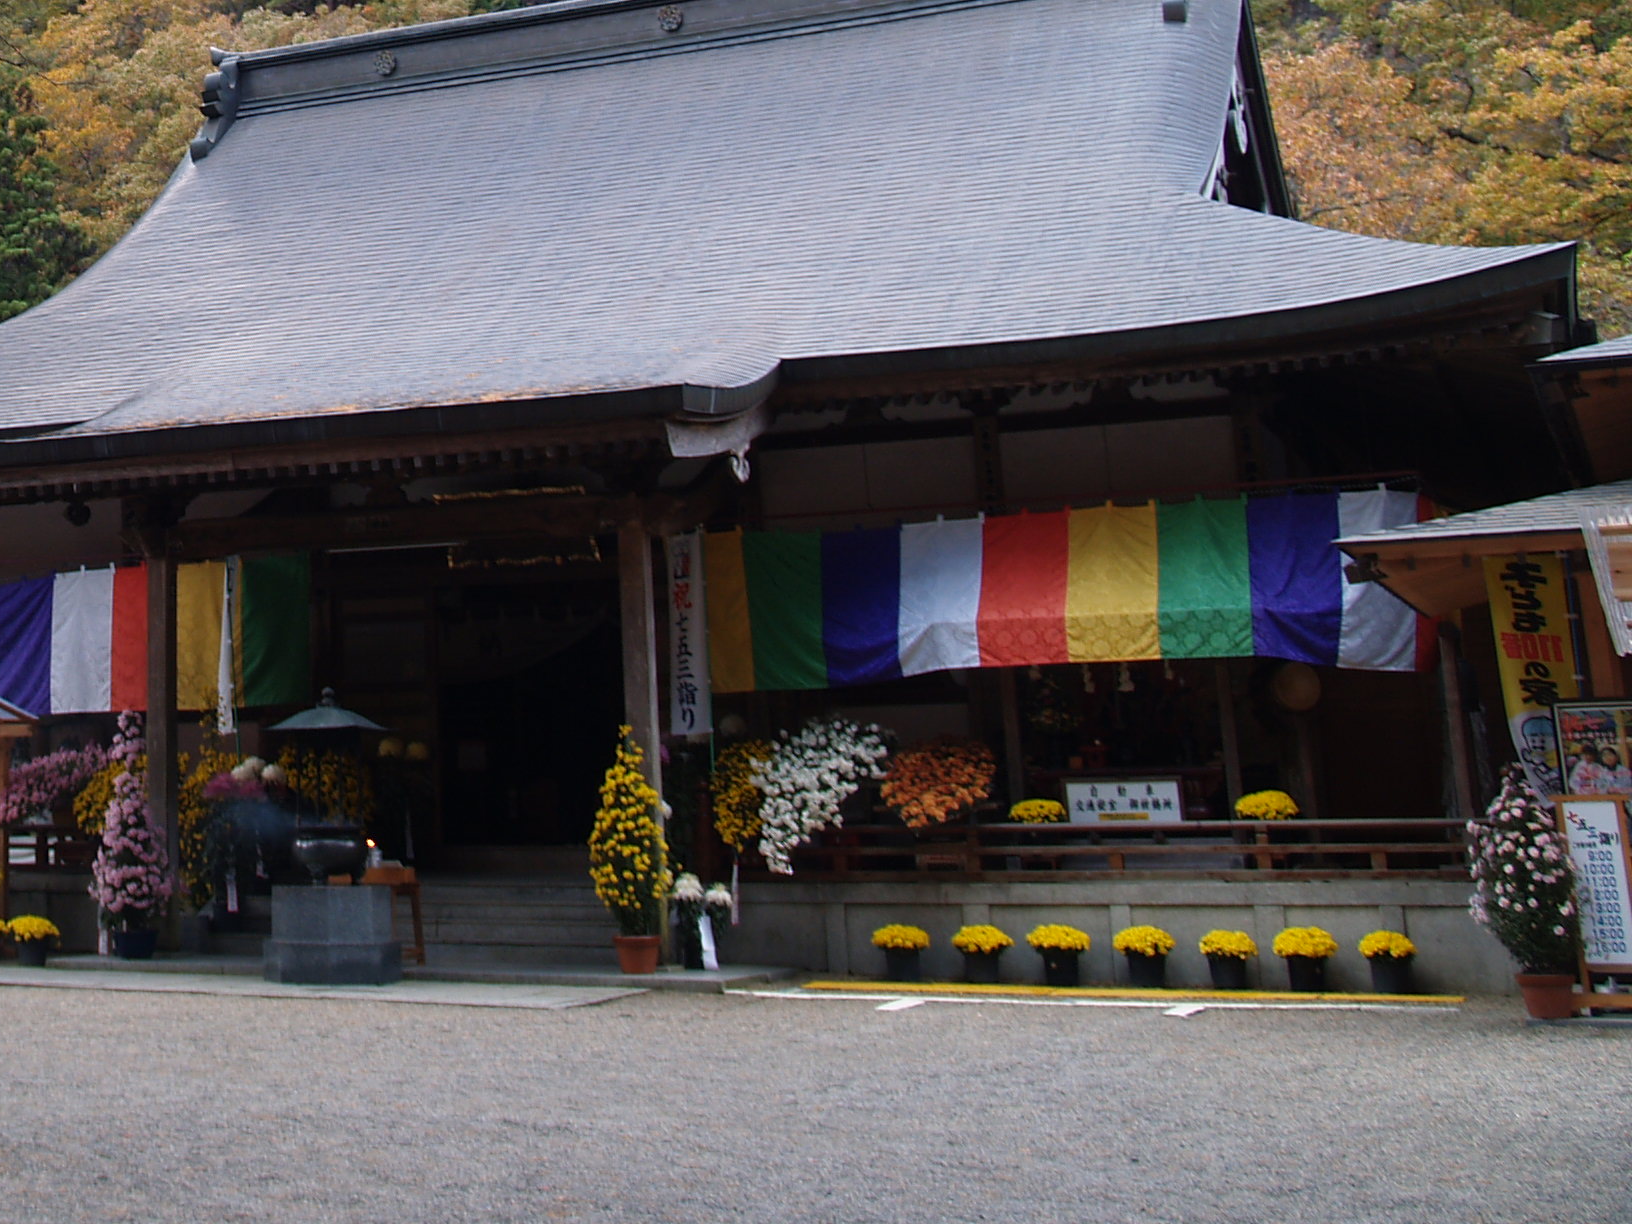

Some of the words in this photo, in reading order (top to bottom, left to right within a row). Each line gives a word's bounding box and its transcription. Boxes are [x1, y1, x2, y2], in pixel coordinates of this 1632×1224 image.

[1588, 850, 1613, 861] 9:00
[1584, 863, 1615, 875] 10:00
[1585, 876, 1617, 888] 11:00
[1594, 889, 1619, 901] 2:00
[1591, 915, 1623, 927] 14:00
